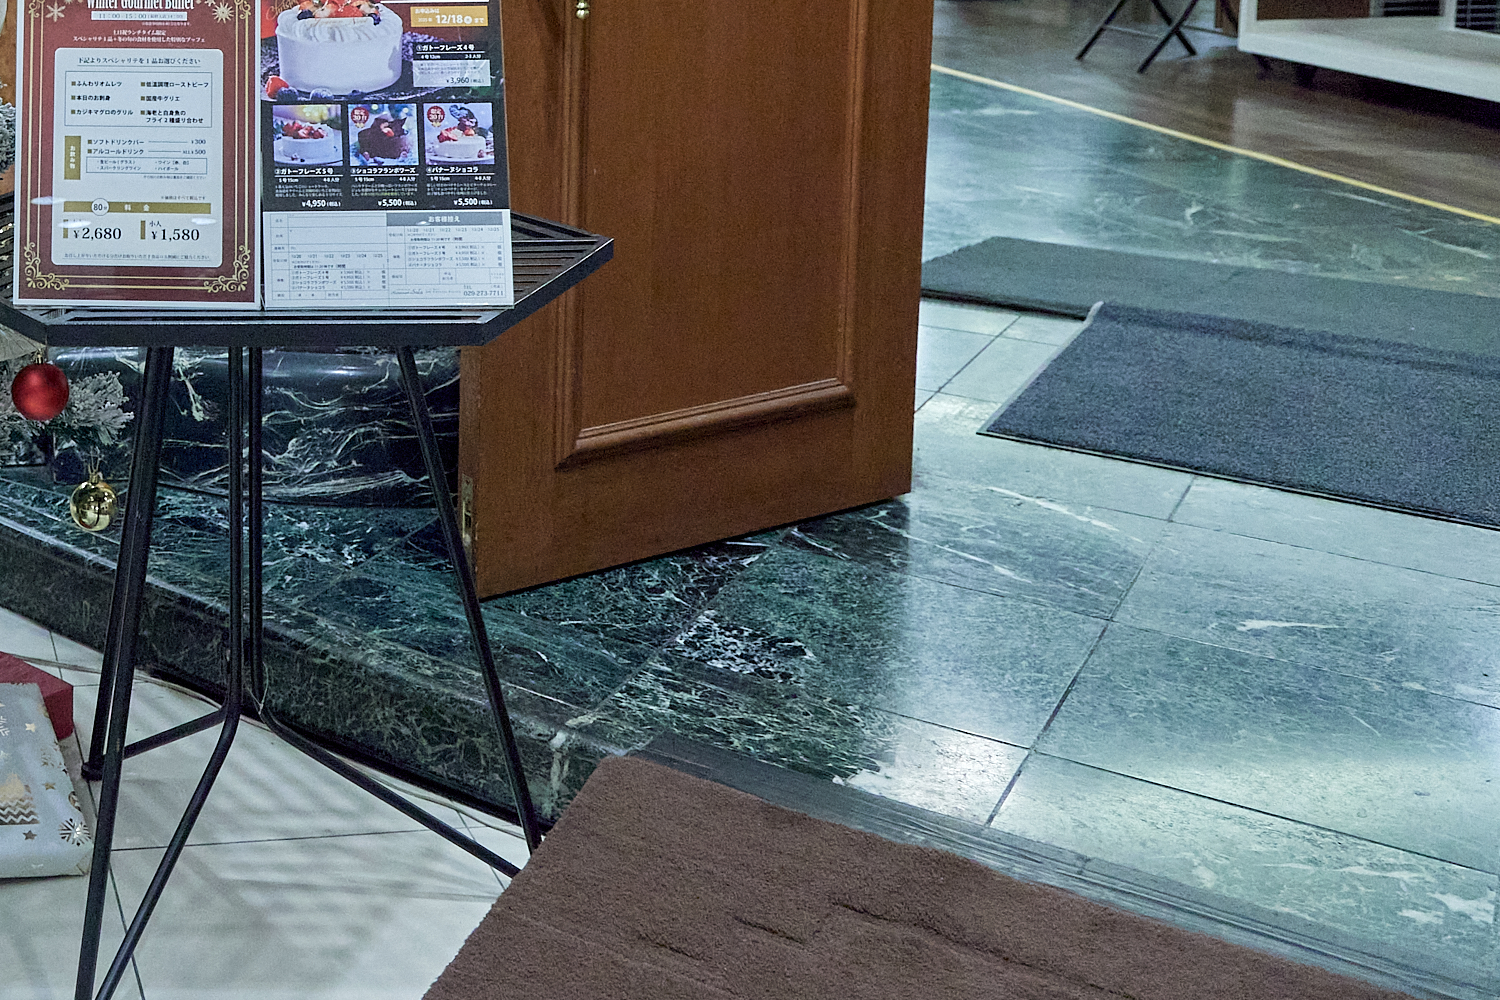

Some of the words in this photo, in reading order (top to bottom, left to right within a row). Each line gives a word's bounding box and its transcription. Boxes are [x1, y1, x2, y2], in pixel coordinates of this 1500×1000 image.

[435, 15, 463, 24] 12/18
[428, 215, 460, 223] お客様控え
[74, 228, 122, 241] ¥2,680
[152, 229, 200, 242] ¥1,580
